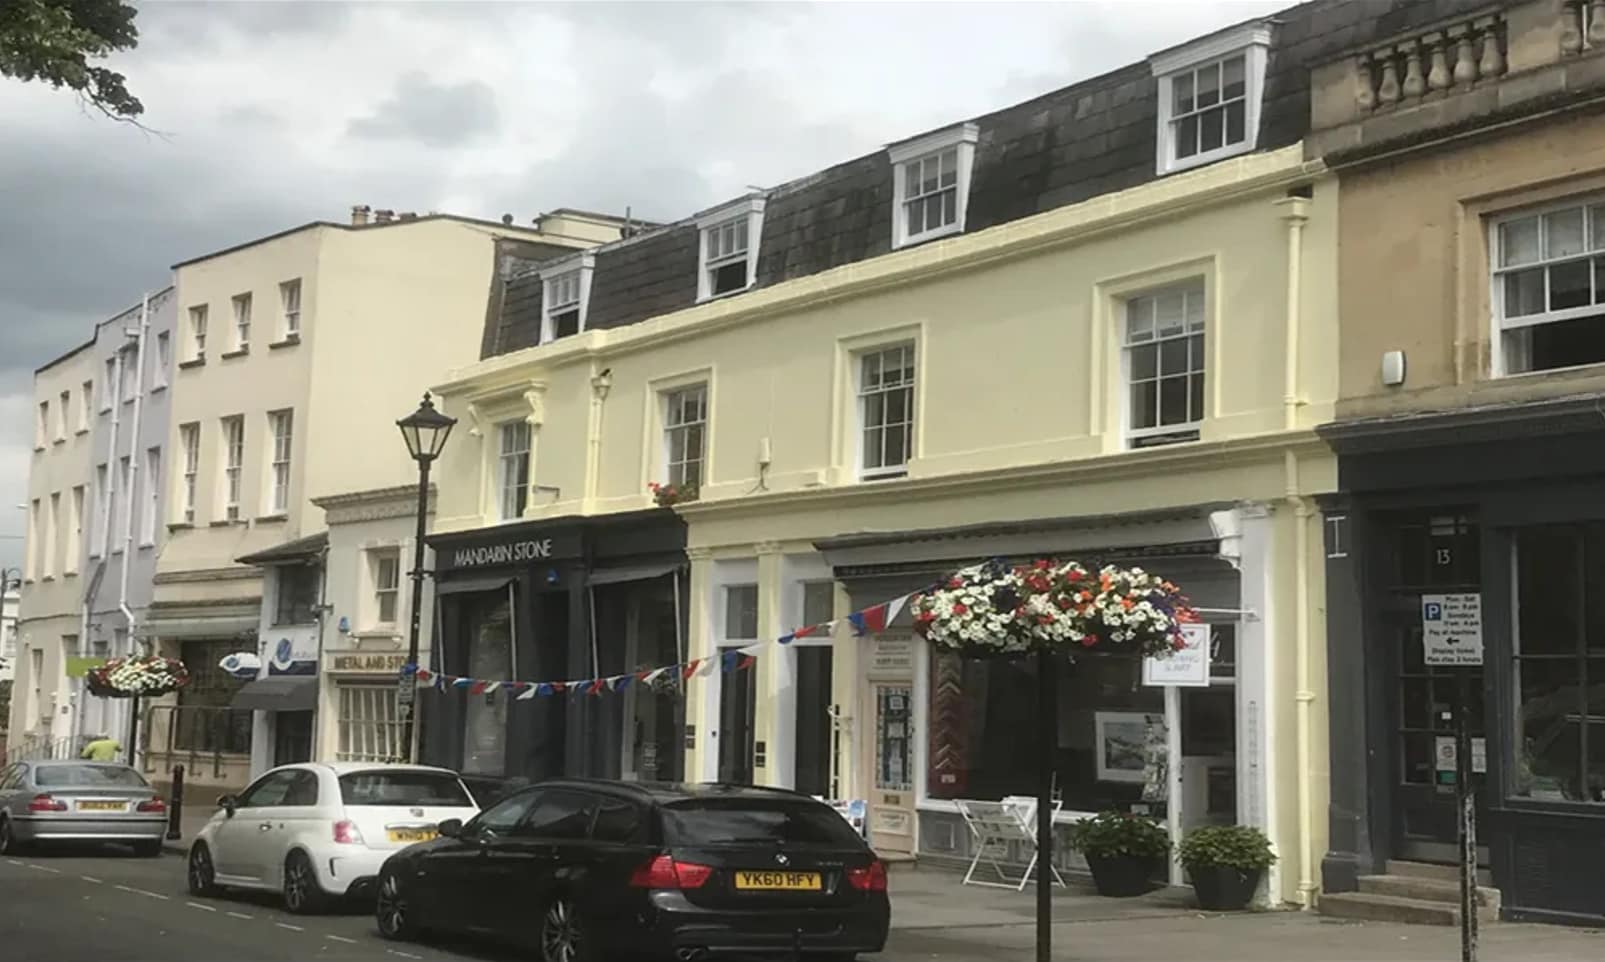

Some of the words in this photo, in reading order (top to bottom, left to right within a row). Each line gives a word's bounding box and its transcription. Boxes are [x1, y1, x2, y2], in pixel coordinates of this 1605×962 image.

[454, 543, 513, 567] MANDARIN
[514, 539, 553, 561] STONE
[1436, 549, 1450, 565] 13
[1428, 604, 1440, 619] P
[334, 656, 363, 670] METAL
[365, 656, 386, 670] AND
[387, 655, 410, 669] STO
[743, 872, 783, 886] YK60
[784, 872, 815, 886] HFY
